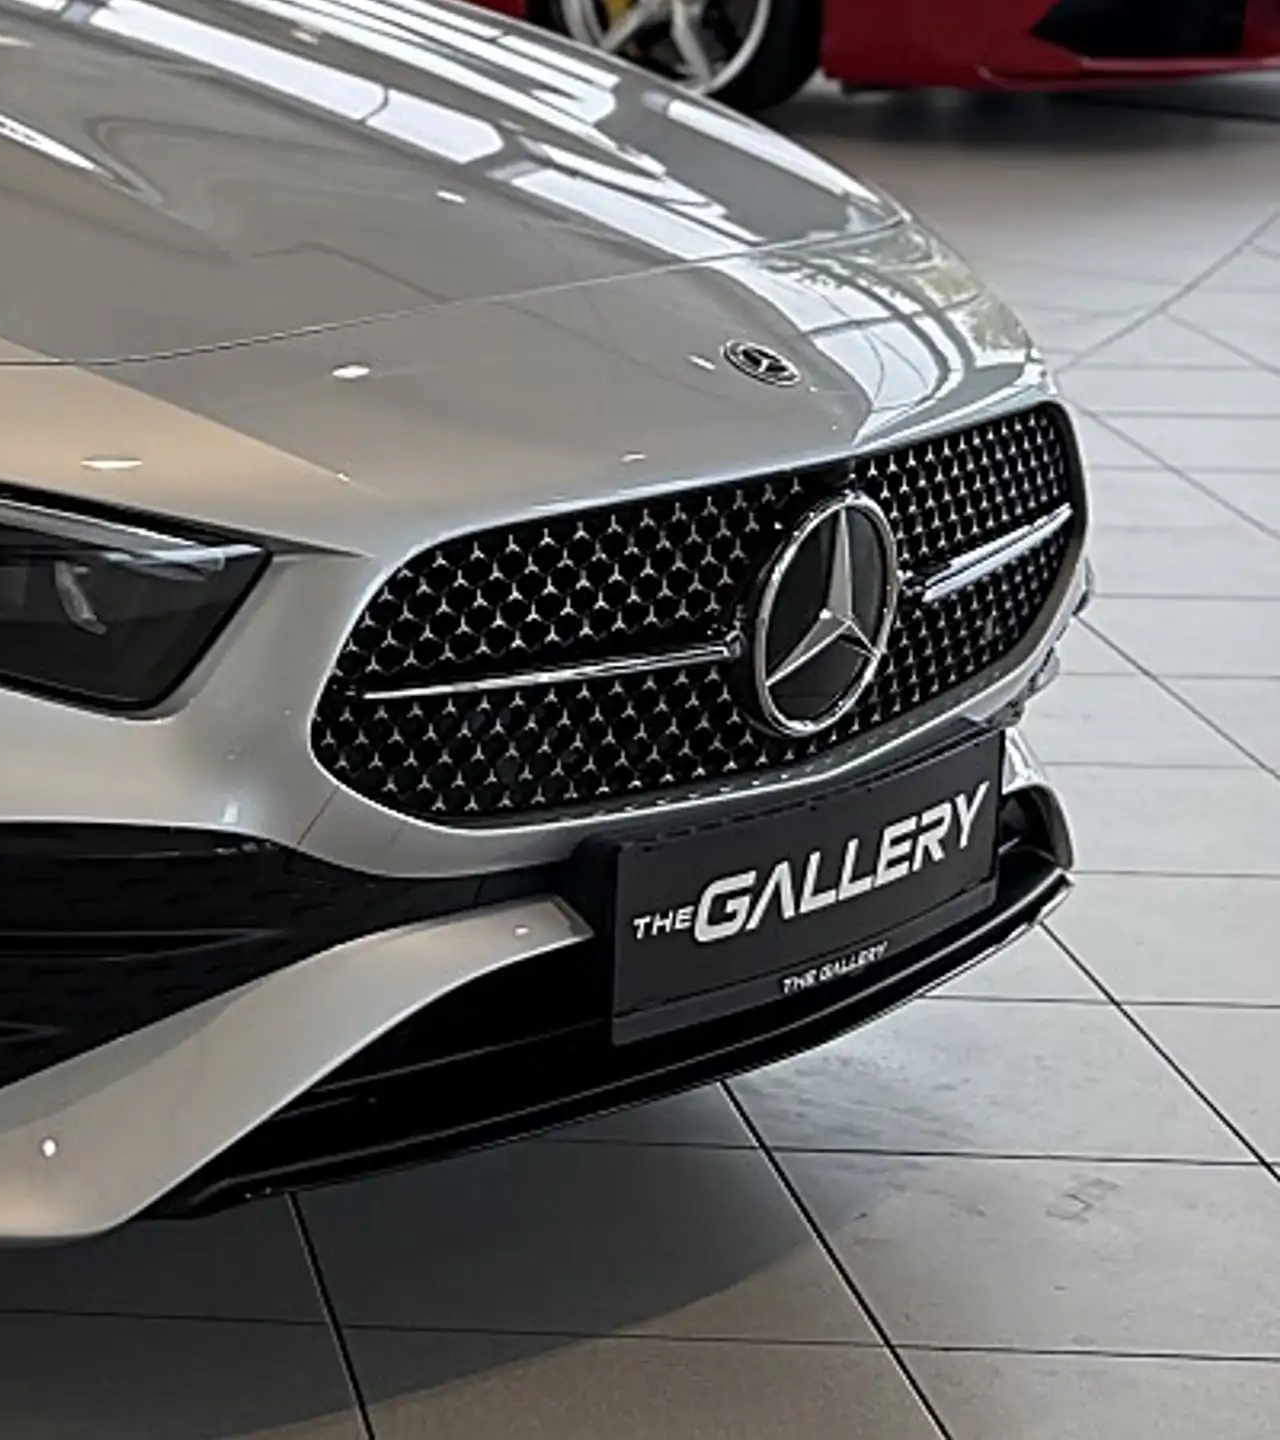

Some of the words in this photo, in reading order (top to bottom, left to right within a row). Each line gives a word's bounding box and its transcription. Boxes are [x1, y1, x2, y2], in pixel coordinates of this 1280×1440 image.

[633, 906, 695, 940] THE
[694, 780, 990, 943] GALLERY
[783, 968, 818, 995] THE
[819, 940, 889, 981] GALLERY
